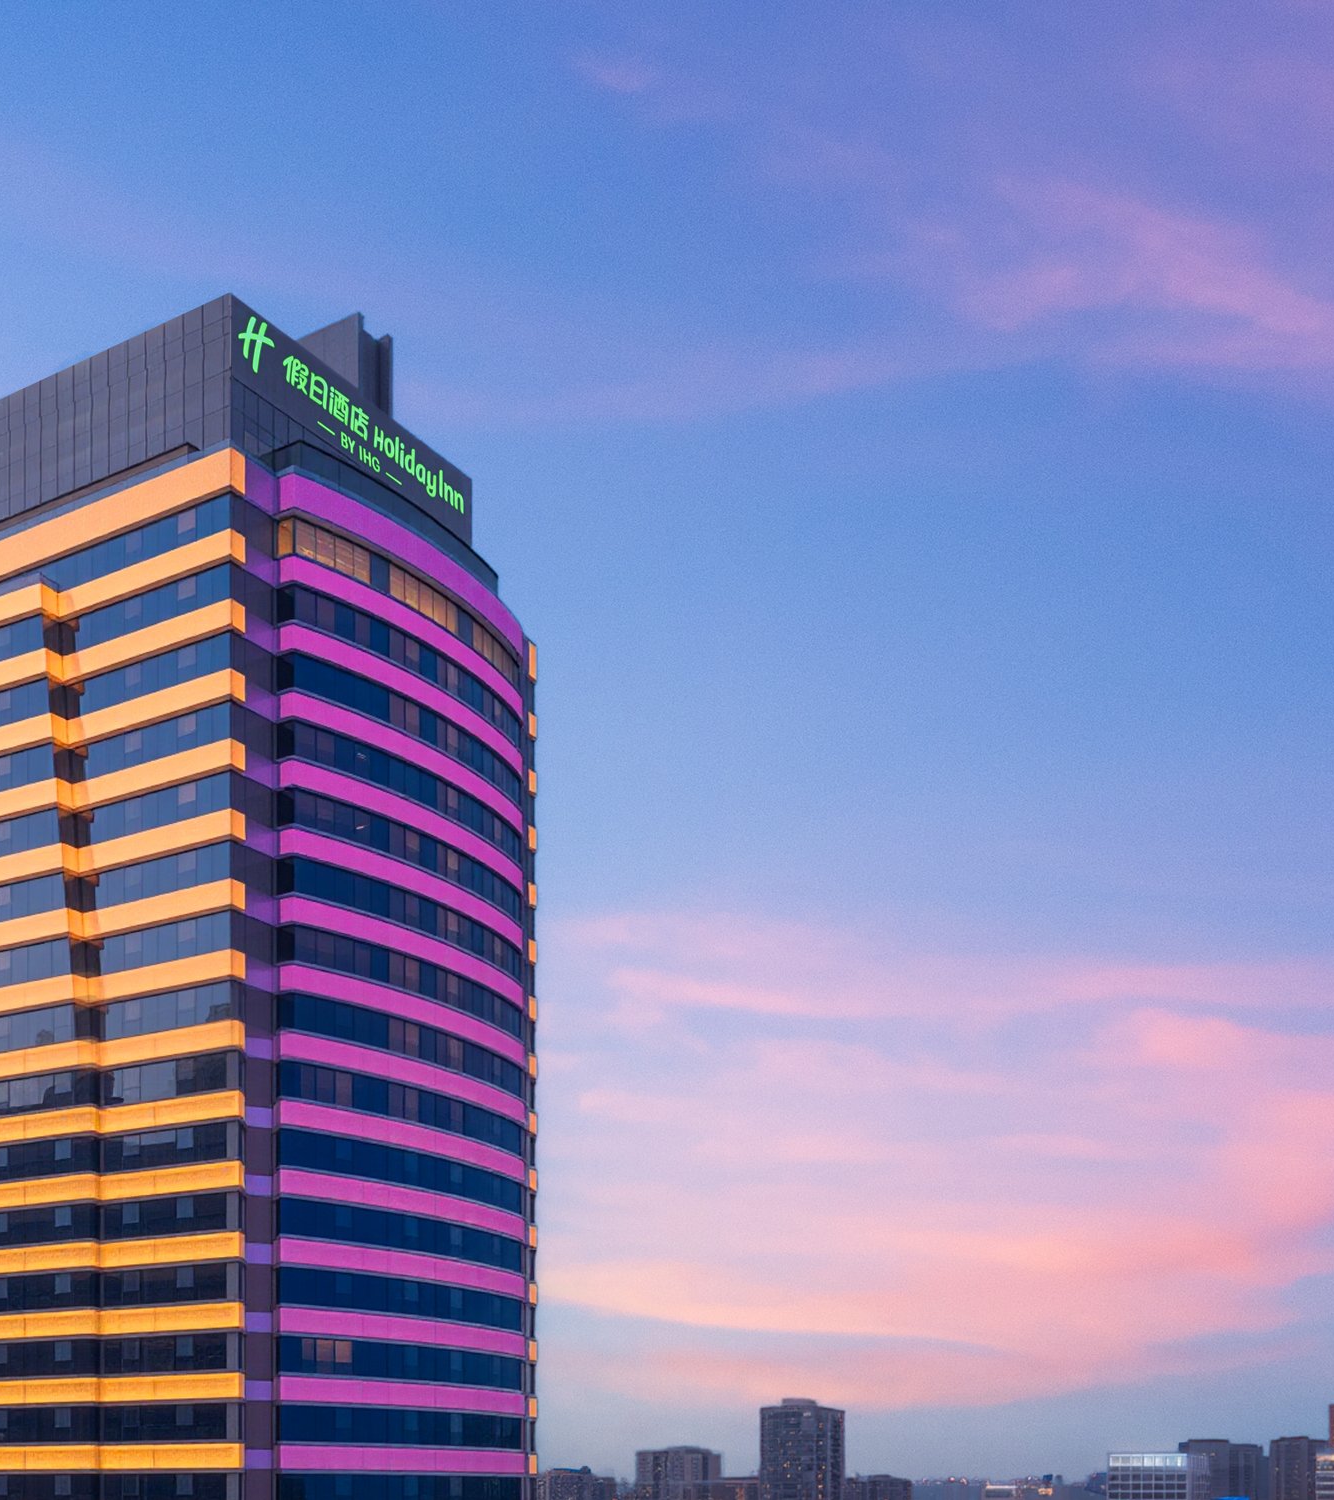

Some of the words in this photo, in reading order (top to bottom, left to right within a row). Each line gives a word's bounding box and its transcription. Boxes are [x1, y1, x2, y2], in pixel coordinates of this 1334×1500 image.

[282, 355, 369, 441] 假日酒店
[340, 431, 355, 454] BY
[358, 445, 381, 473] IHG
